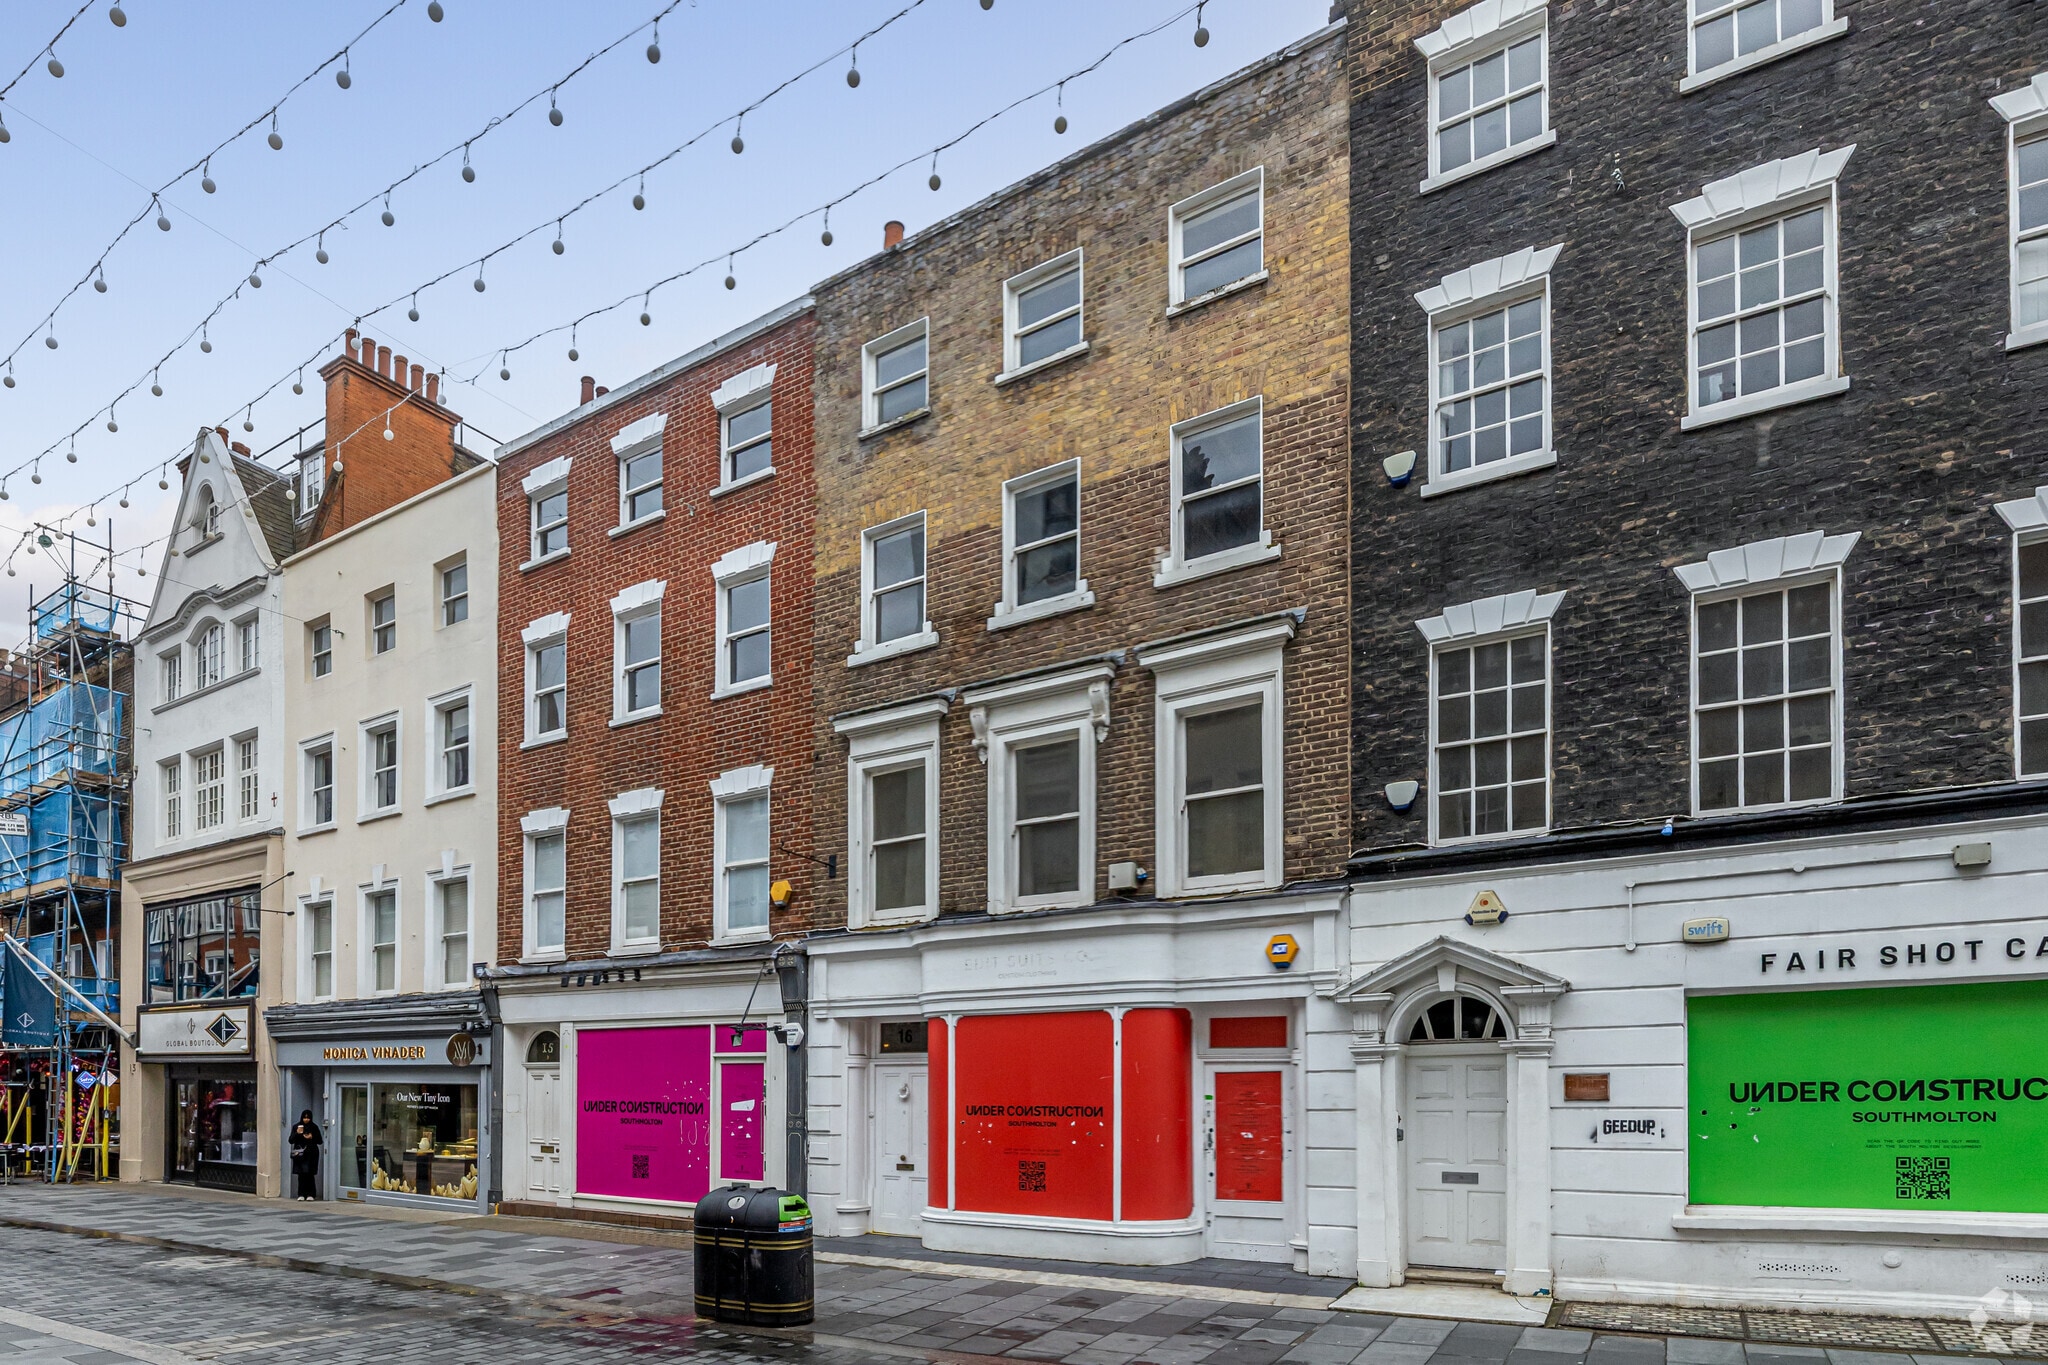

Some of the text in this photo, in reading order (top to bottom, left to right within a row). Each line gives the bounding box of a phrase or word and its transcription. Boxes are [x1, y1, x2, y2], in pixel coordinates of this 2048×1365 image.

[1687, 921, 1723, 937] swift
[1272, 944, 1288, 953] ADT
[1761, 949, 1856, 973] FAIR
[1879, 939, 1984, 967] SHOT
[898, 1029, 913, 1043] 16
[165, 1039, 188, 1047] GLOBAL
[323, 1045, 426, 1060] MONICA VINADER
[396, 1092, 451, 1104] Our New Tiny Icon
[1852, 1111, 1997, 1123] SOUTHMOLTON
